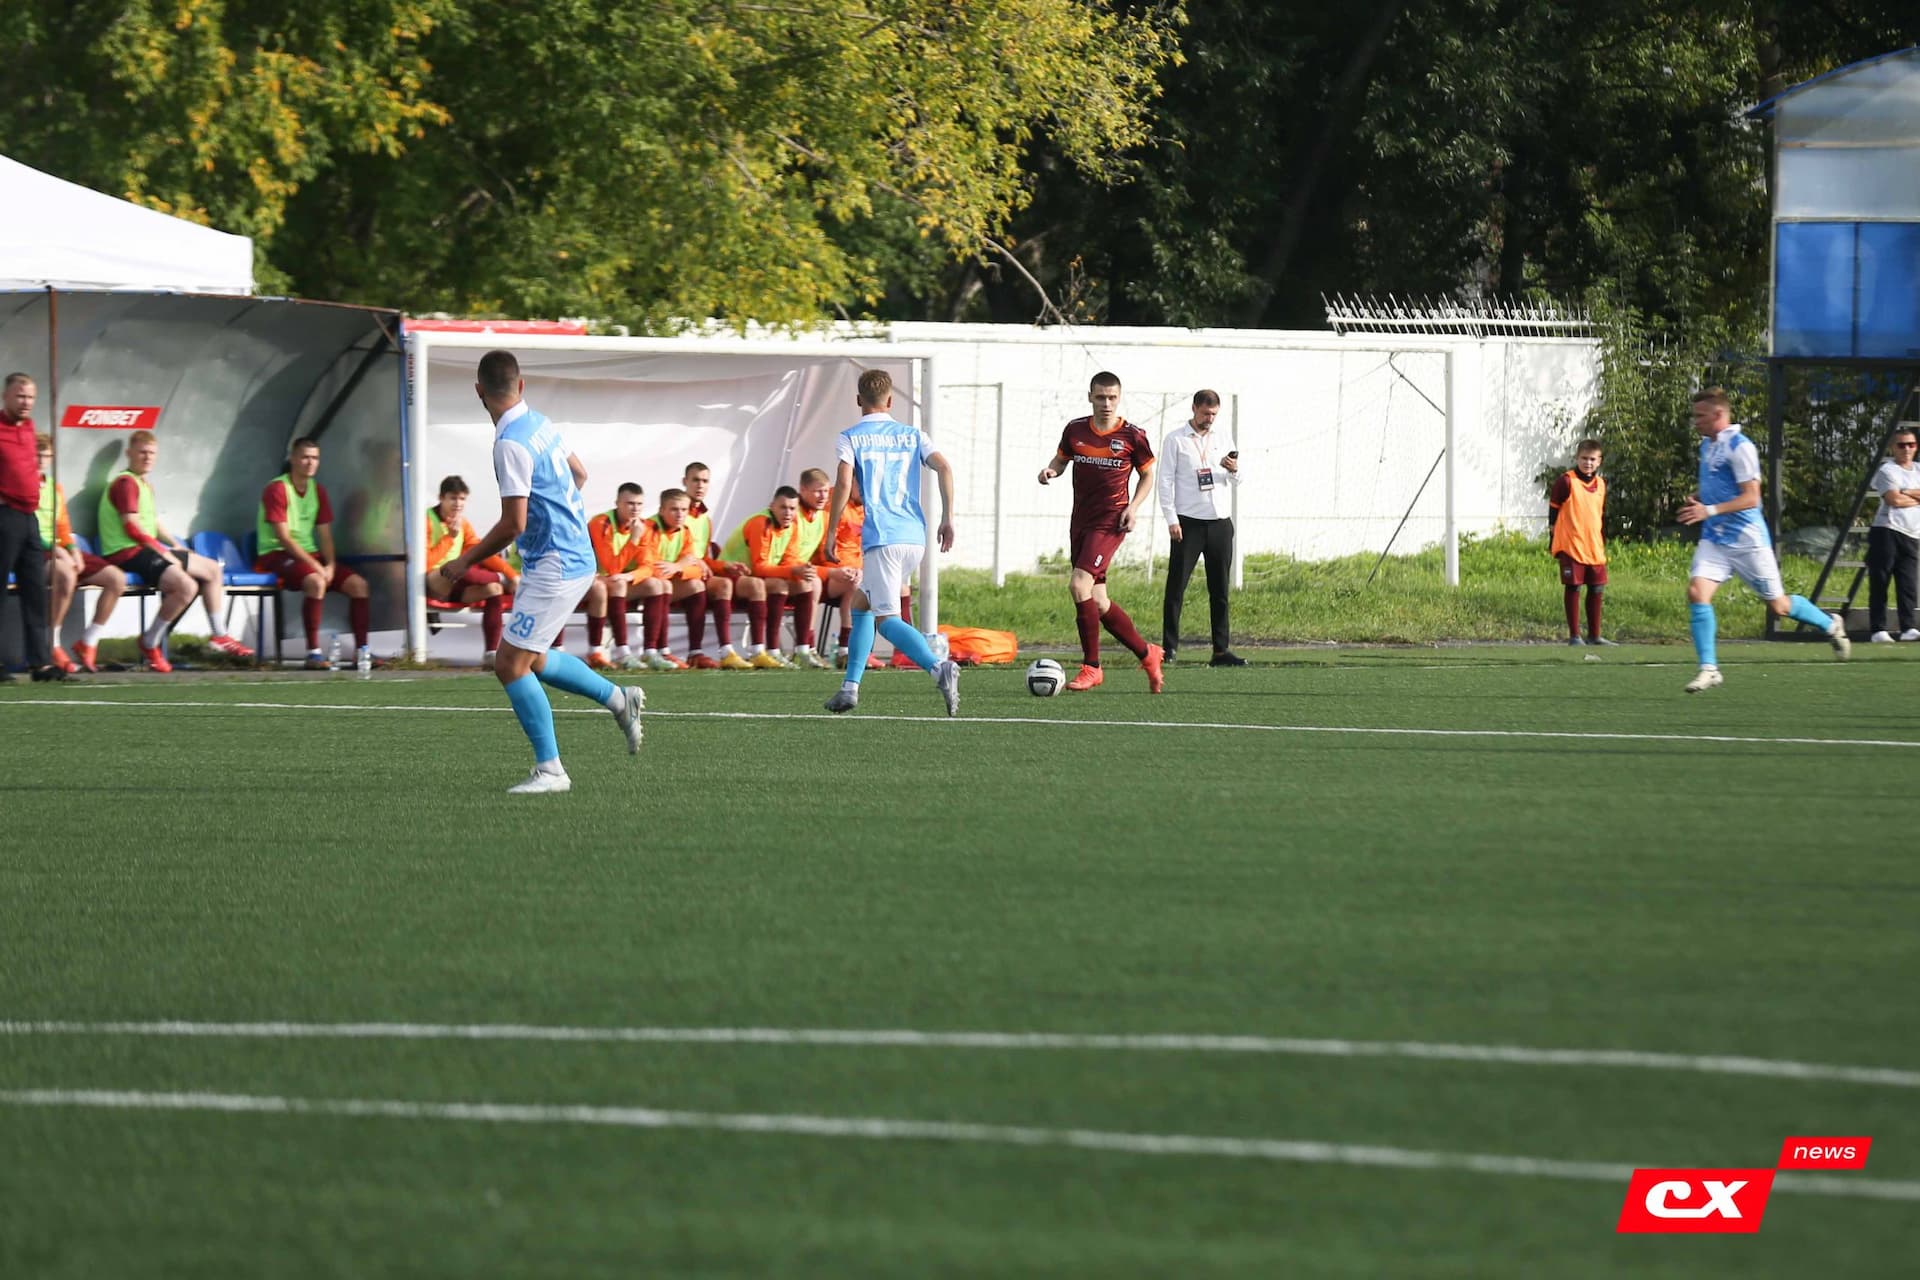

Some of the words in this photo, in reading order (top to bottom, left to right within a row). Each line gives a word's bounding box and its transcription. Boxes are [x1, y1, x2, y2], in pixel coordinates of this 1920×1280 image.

[78, 409, 144, 426] FONBET
[860, 451, 912, 506] 77
[1094, 554, 1103, 567] 9
[509, 611, 536, 638] 29
